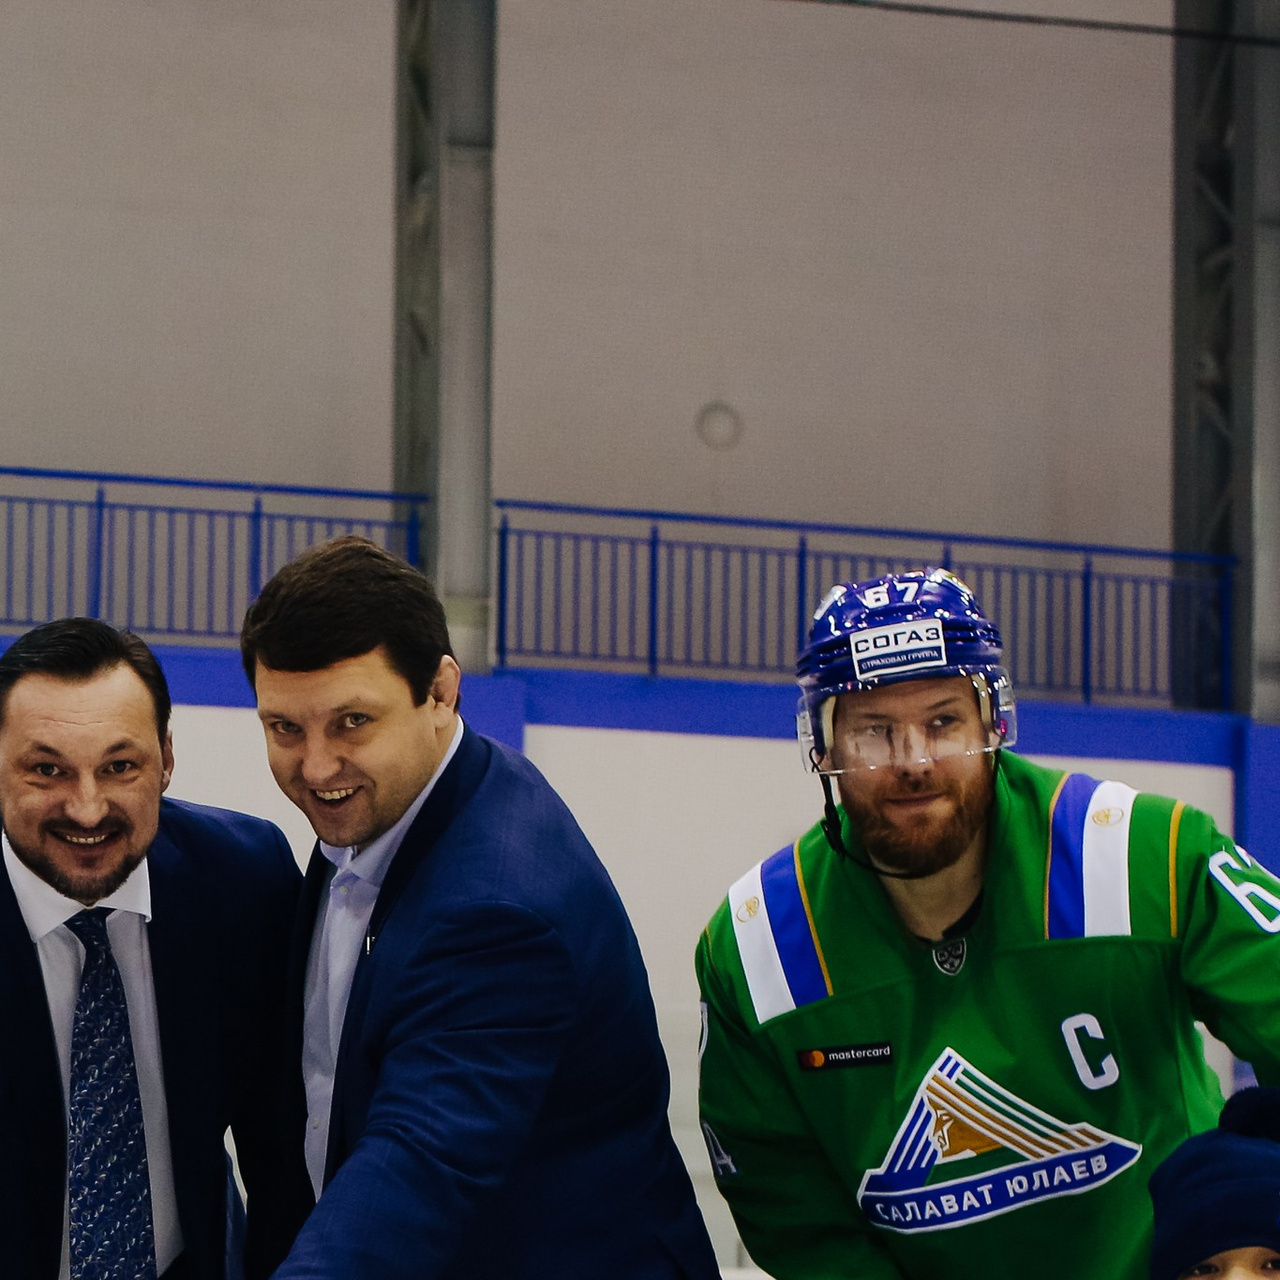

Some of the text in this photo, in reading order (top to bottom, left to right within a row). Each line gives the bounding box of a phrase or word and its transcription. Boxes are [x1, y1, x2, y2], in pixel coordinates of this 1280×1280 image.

[864, 581, 919, 609] 67
[855, 627, 940, 654] СОГАЗ
[861, 650, 939, 670] СТРАХОВАЯ ГРУППА
[828, 1045, 890, 1061] mastercard
[876, 1155, 1108, 1222] САЛАВАТ ЮЛАЕВ
